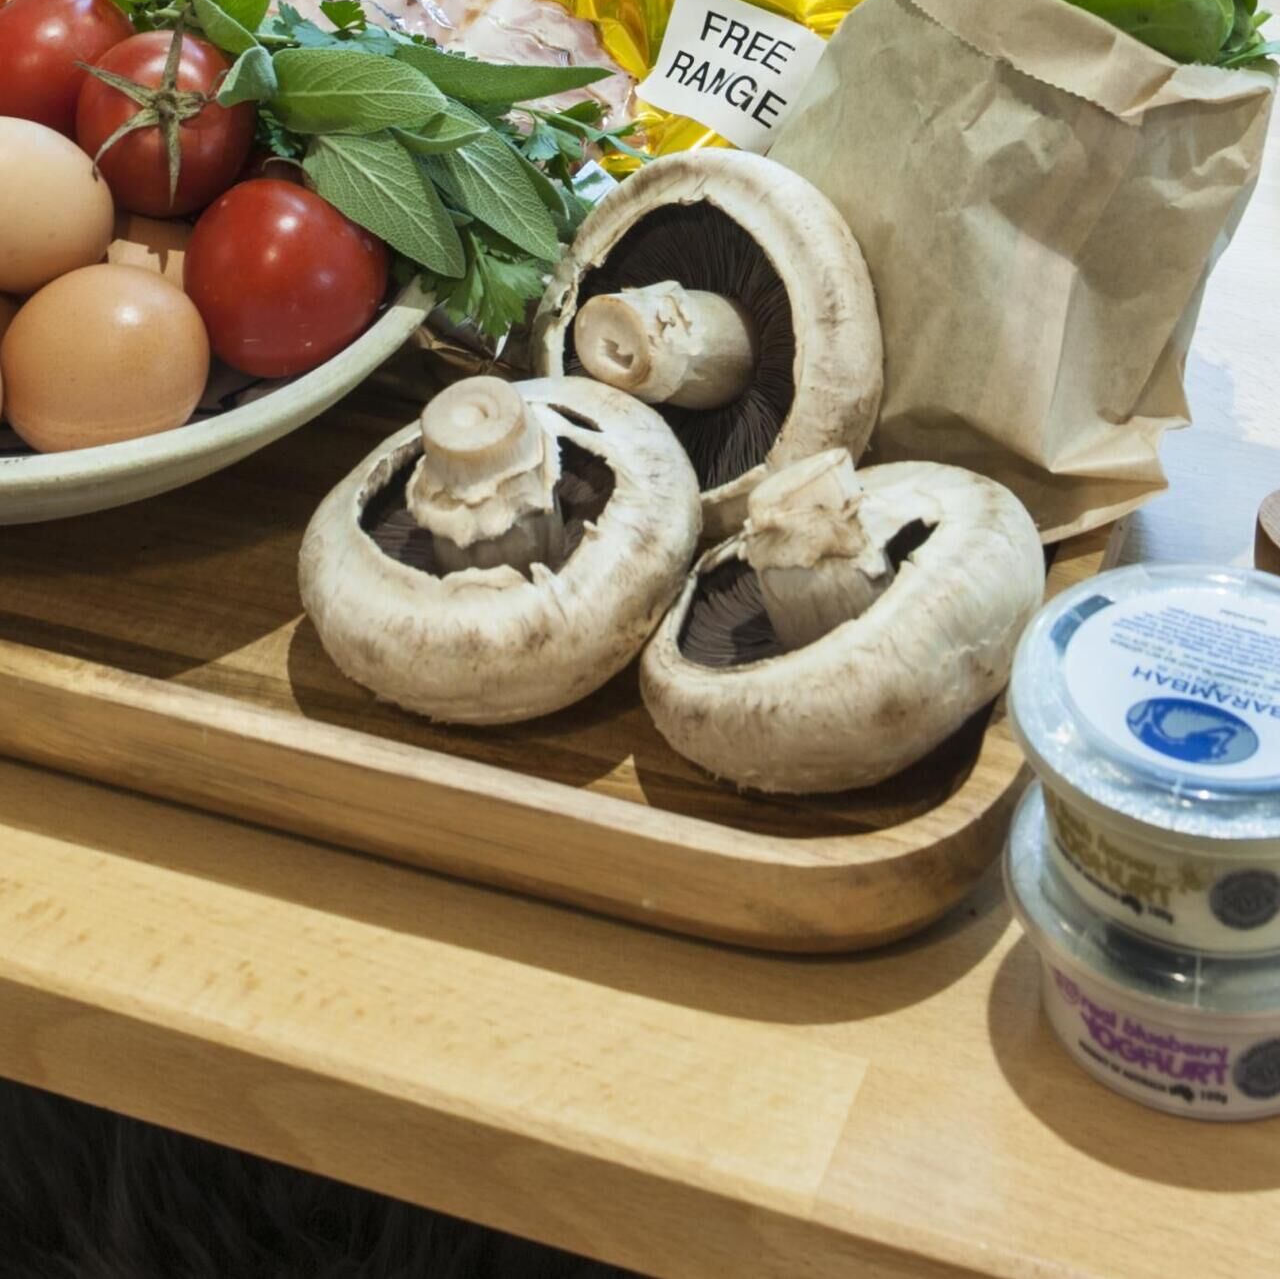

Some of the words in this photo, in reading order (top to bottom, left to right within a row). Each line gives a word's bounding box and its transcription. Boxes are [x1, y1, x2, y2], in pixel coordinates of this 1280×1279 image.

[700, 10, 796, 75] FREE
[665, 50, 788, 129] RANGE
[1080, 1010, 1231, 1087] YOGHURT
